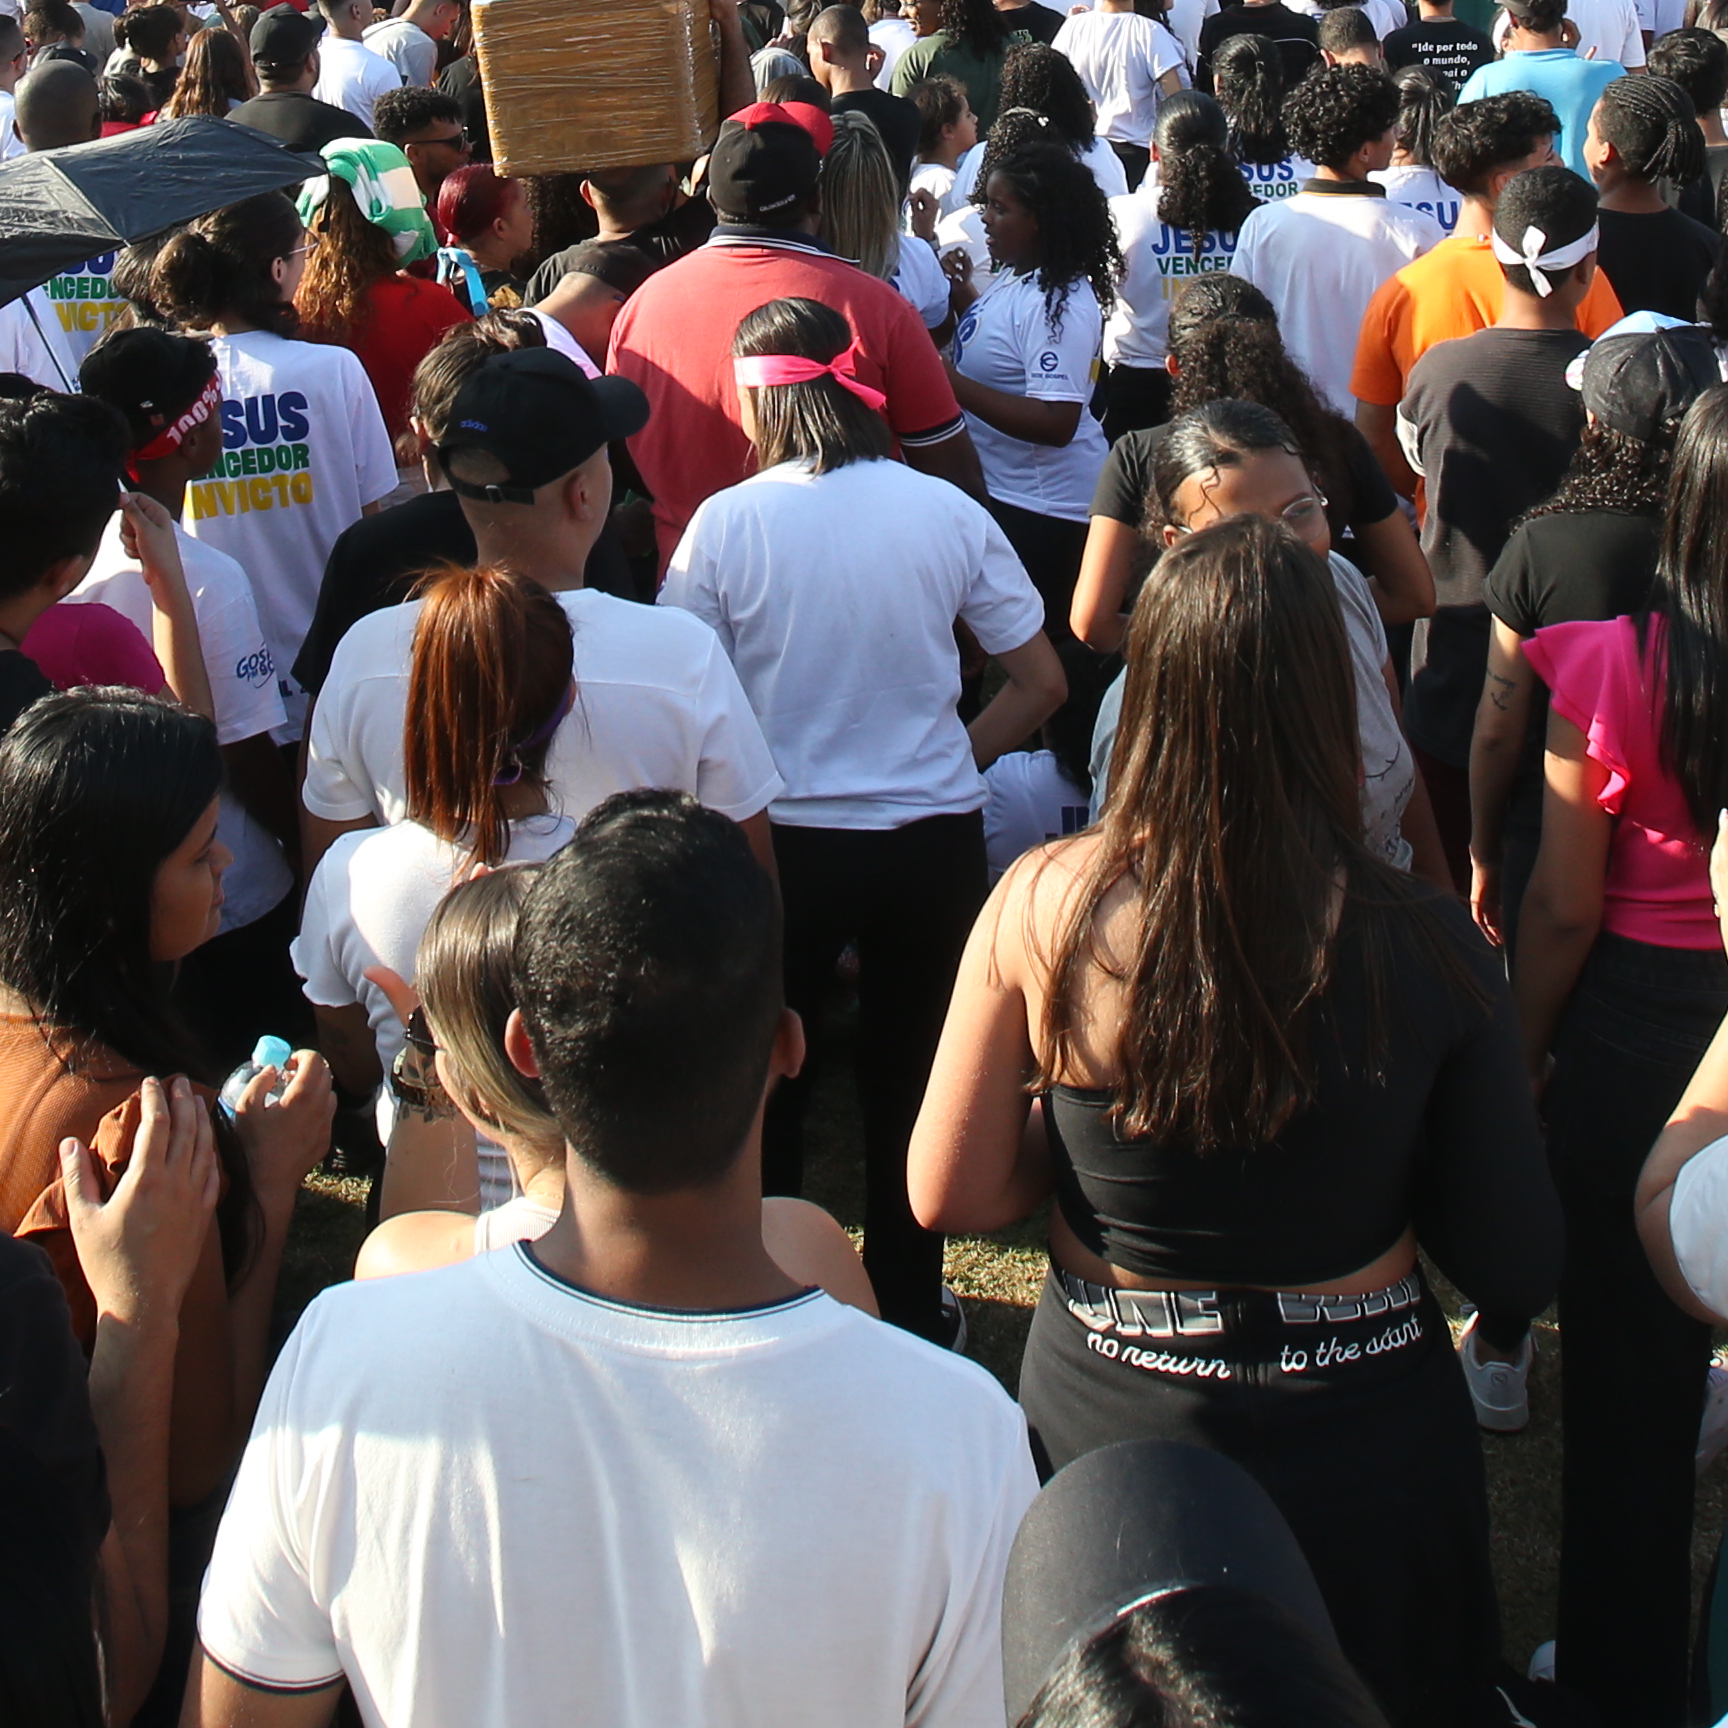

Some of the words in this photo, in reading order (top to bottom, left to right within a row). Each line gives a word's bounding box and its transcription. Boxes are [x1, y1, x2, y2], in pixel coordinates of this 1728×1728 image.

[1436, 43, 1454, 55] por
[1456, 41, 1478, 52] todo
[1432, 55, 1471, 66] mundo,
[1239, 159, 1294, 182] SUS
[1152, 224, 1240, 256] JESU
[1157, 256, 1233, 276] VENCE
[222, 390, 312, 450] SUS
[1087, 1332, 1120, 1359] no
[1121, 1345, 1233, 1380] return
[1280, 1346, 1313, 1372] to
[1315, 1336, 1363, 1369] the
[1365, 1312, 1424, 1355] start
